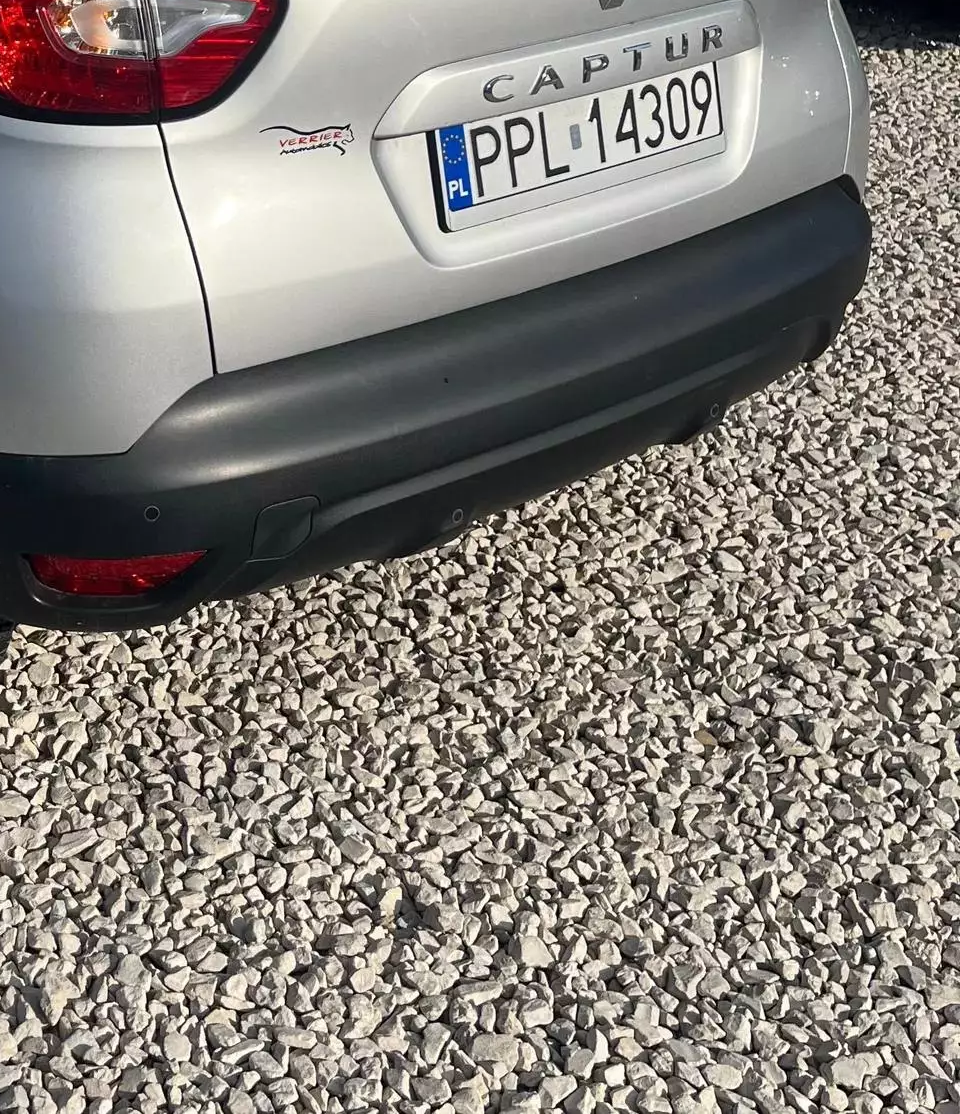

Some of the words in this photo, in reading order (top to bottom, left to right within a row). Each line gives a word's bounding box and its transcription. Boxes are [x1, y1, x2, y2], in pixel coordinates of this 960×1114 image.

[483, 24, 723, 103] CAPTUR
[279, 131, 342, 148] VERRIER
[448, 178, 469, 200] PL
[469, 111, 571, 198] PPL
[588, 70, 713, 164] 14309
